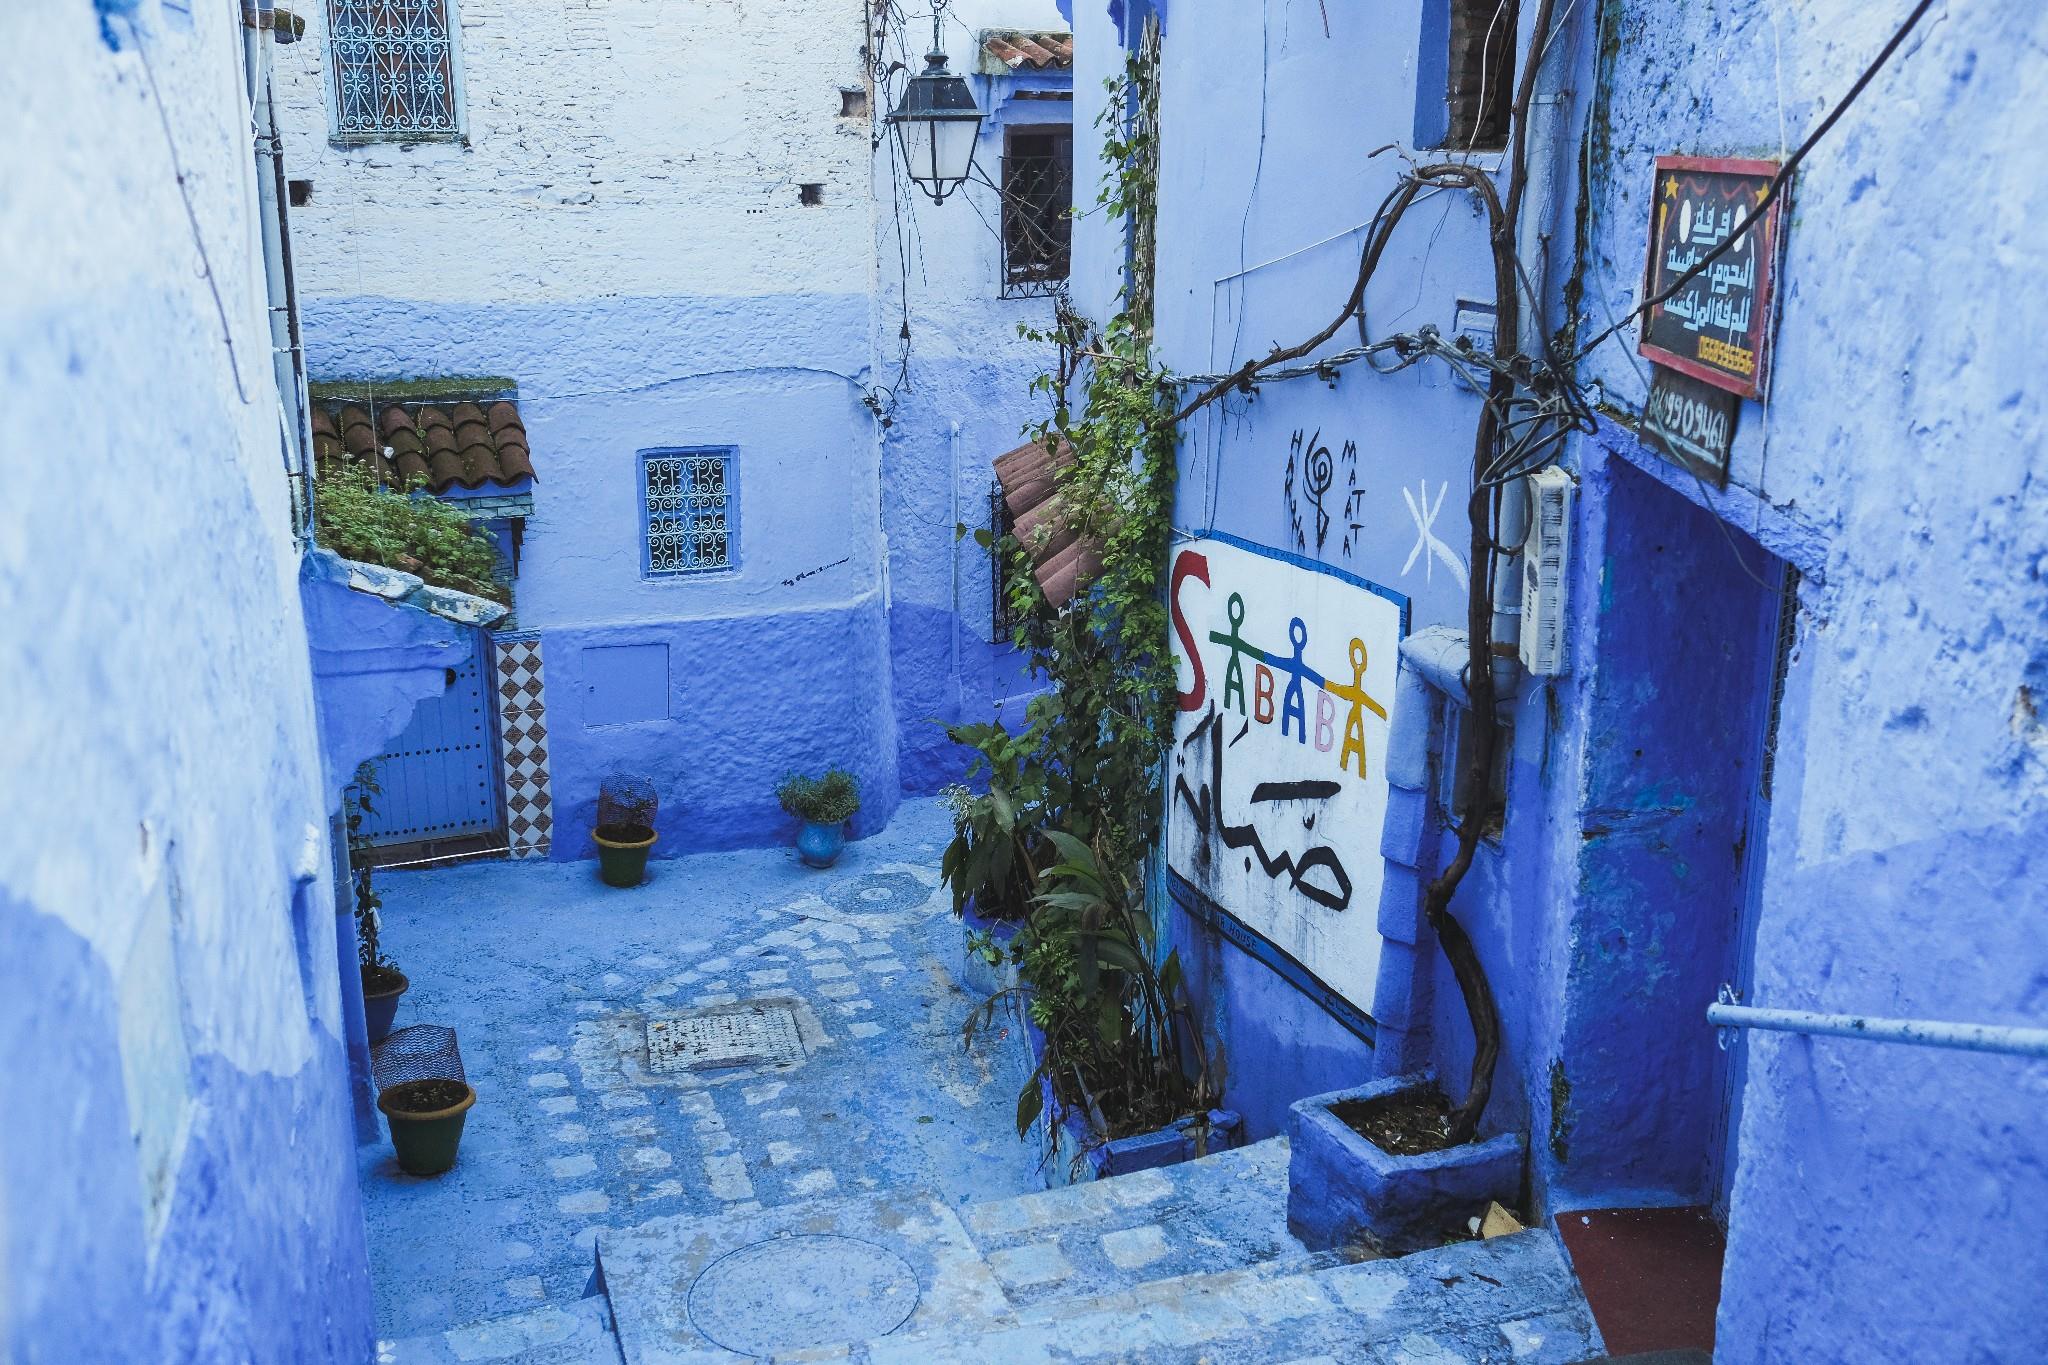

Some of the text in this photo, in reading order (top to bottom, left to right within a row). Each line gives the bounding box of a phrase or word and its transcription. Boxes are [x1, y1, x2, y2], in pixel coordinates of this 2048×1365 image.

[1284, 428, 1306, 551] HAKUNA
[1171, 549, 1387, 781] SABABA
[1228, 922, 1258, 950] HOUSE
